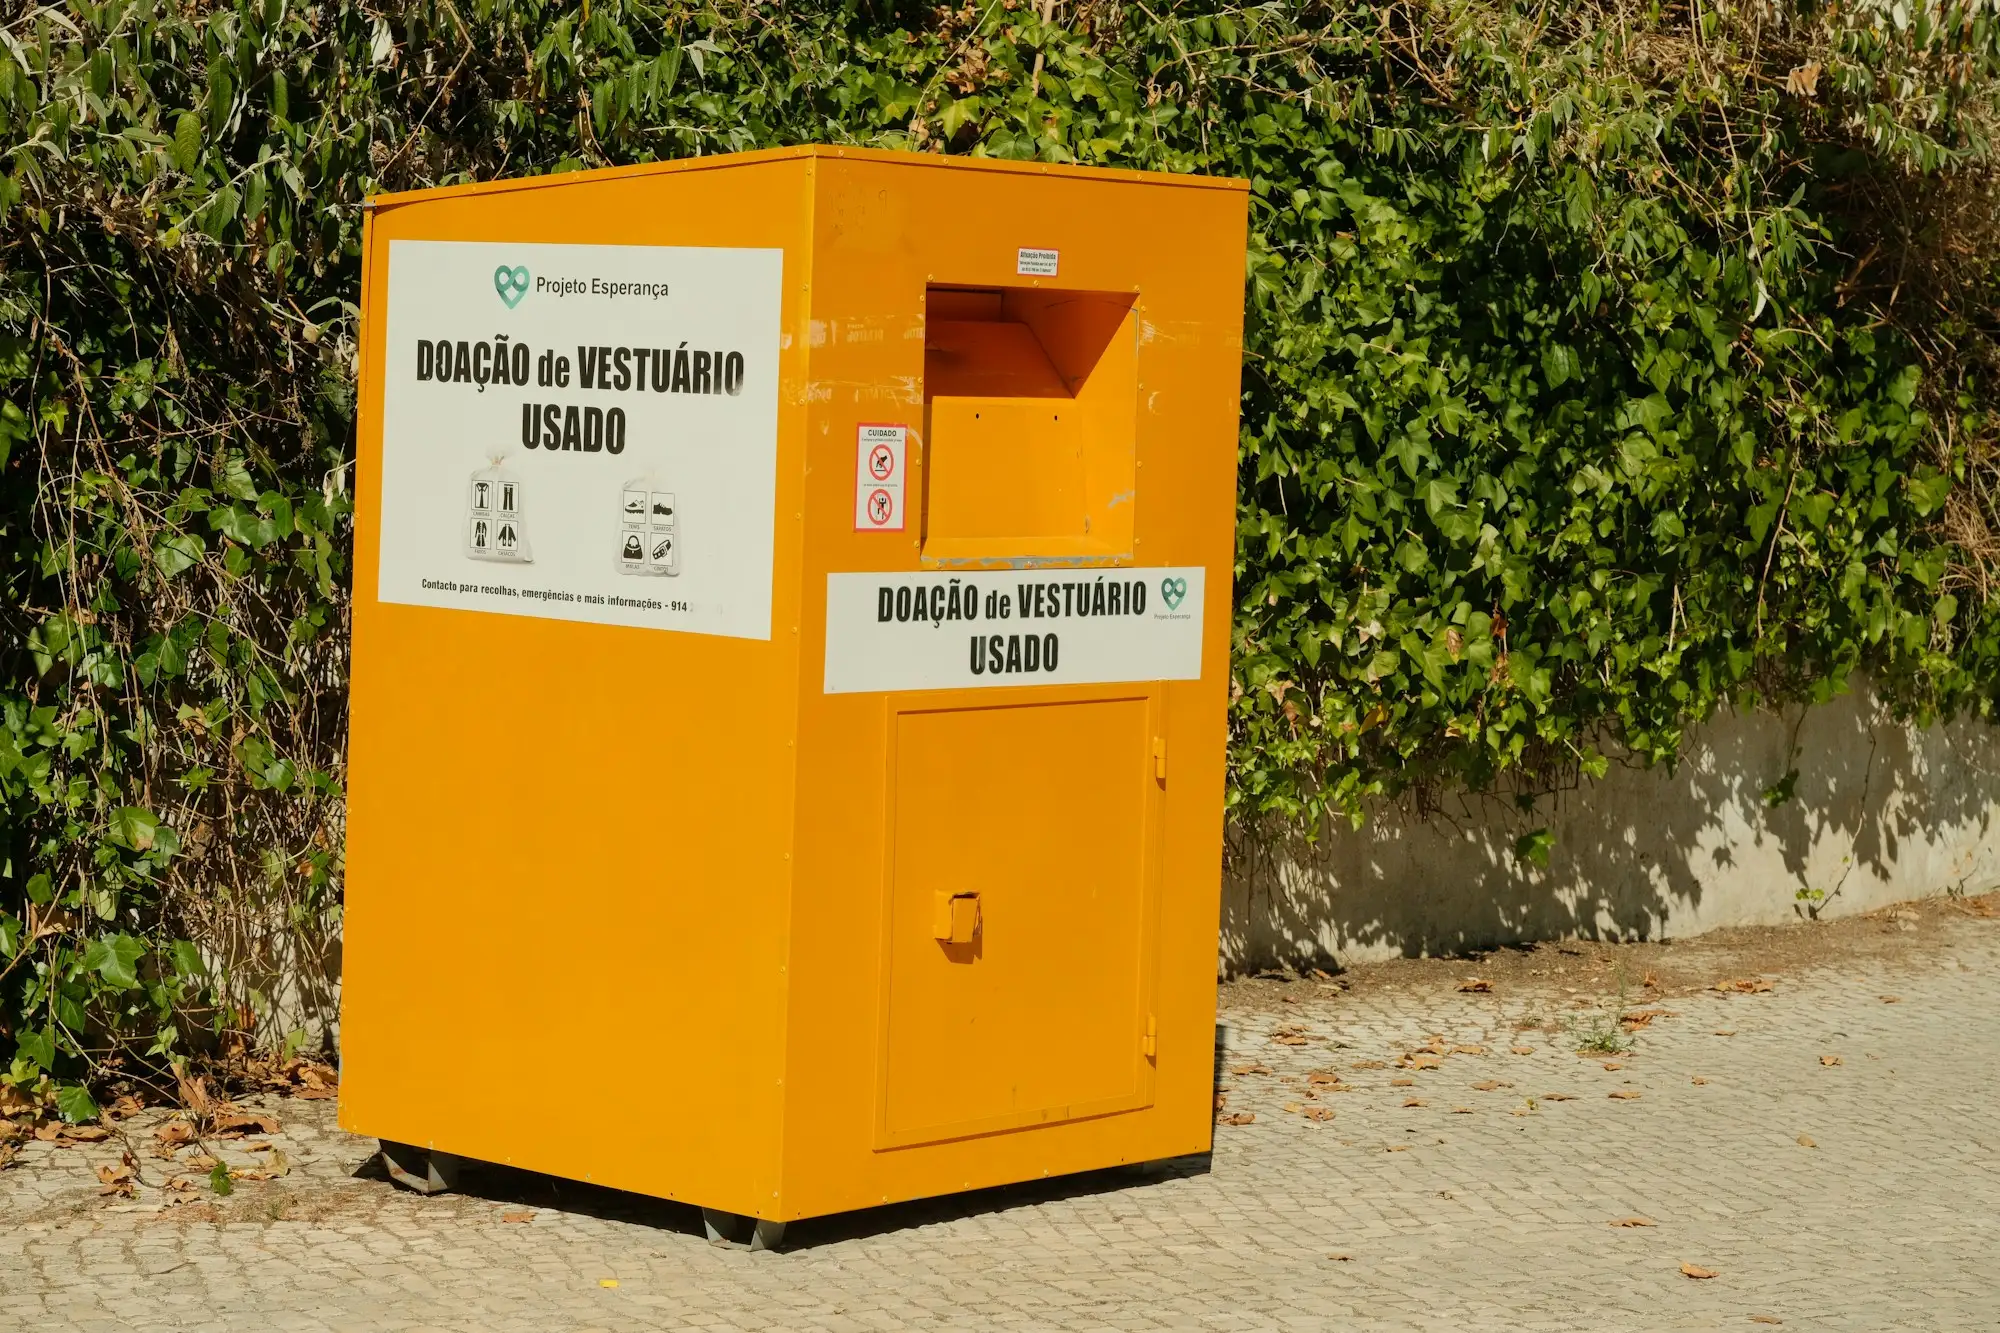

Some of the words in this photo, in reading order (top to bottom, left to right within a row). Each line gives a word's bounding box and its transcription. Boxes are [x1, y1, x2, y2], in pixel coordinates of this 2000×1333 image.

[537, 276, 587, 298] Projeto
[591, 278, 669, 301] Esperança
[417, 333, 530, 394] DOAÇÃO
[538, 349, 571, 388] de
[577, 341, 744, 397] VESTUÁRIO
[522, 403, 627, 455] USADO
[867, 429, 897, 437] CUIDADO
[421, 578, 457, 591] Contacto
[459, 583, 478, 593] para
[480, 585, 520, 598] recolhas,
[521, 589, 574, 602] emergências
[576, 593, 582, 602] e
[584, 594, 605, 605] mais
[607, 595, 662, 611] informações
[671, 601, 687, 612] 914
[877, 578, 979, 628] DOAÇÃO
[985, 589, 1011, 620] de
[1018, 576, 1146, 618] VESTUÁRIO
[970, 632, 1059, 675] USADO
